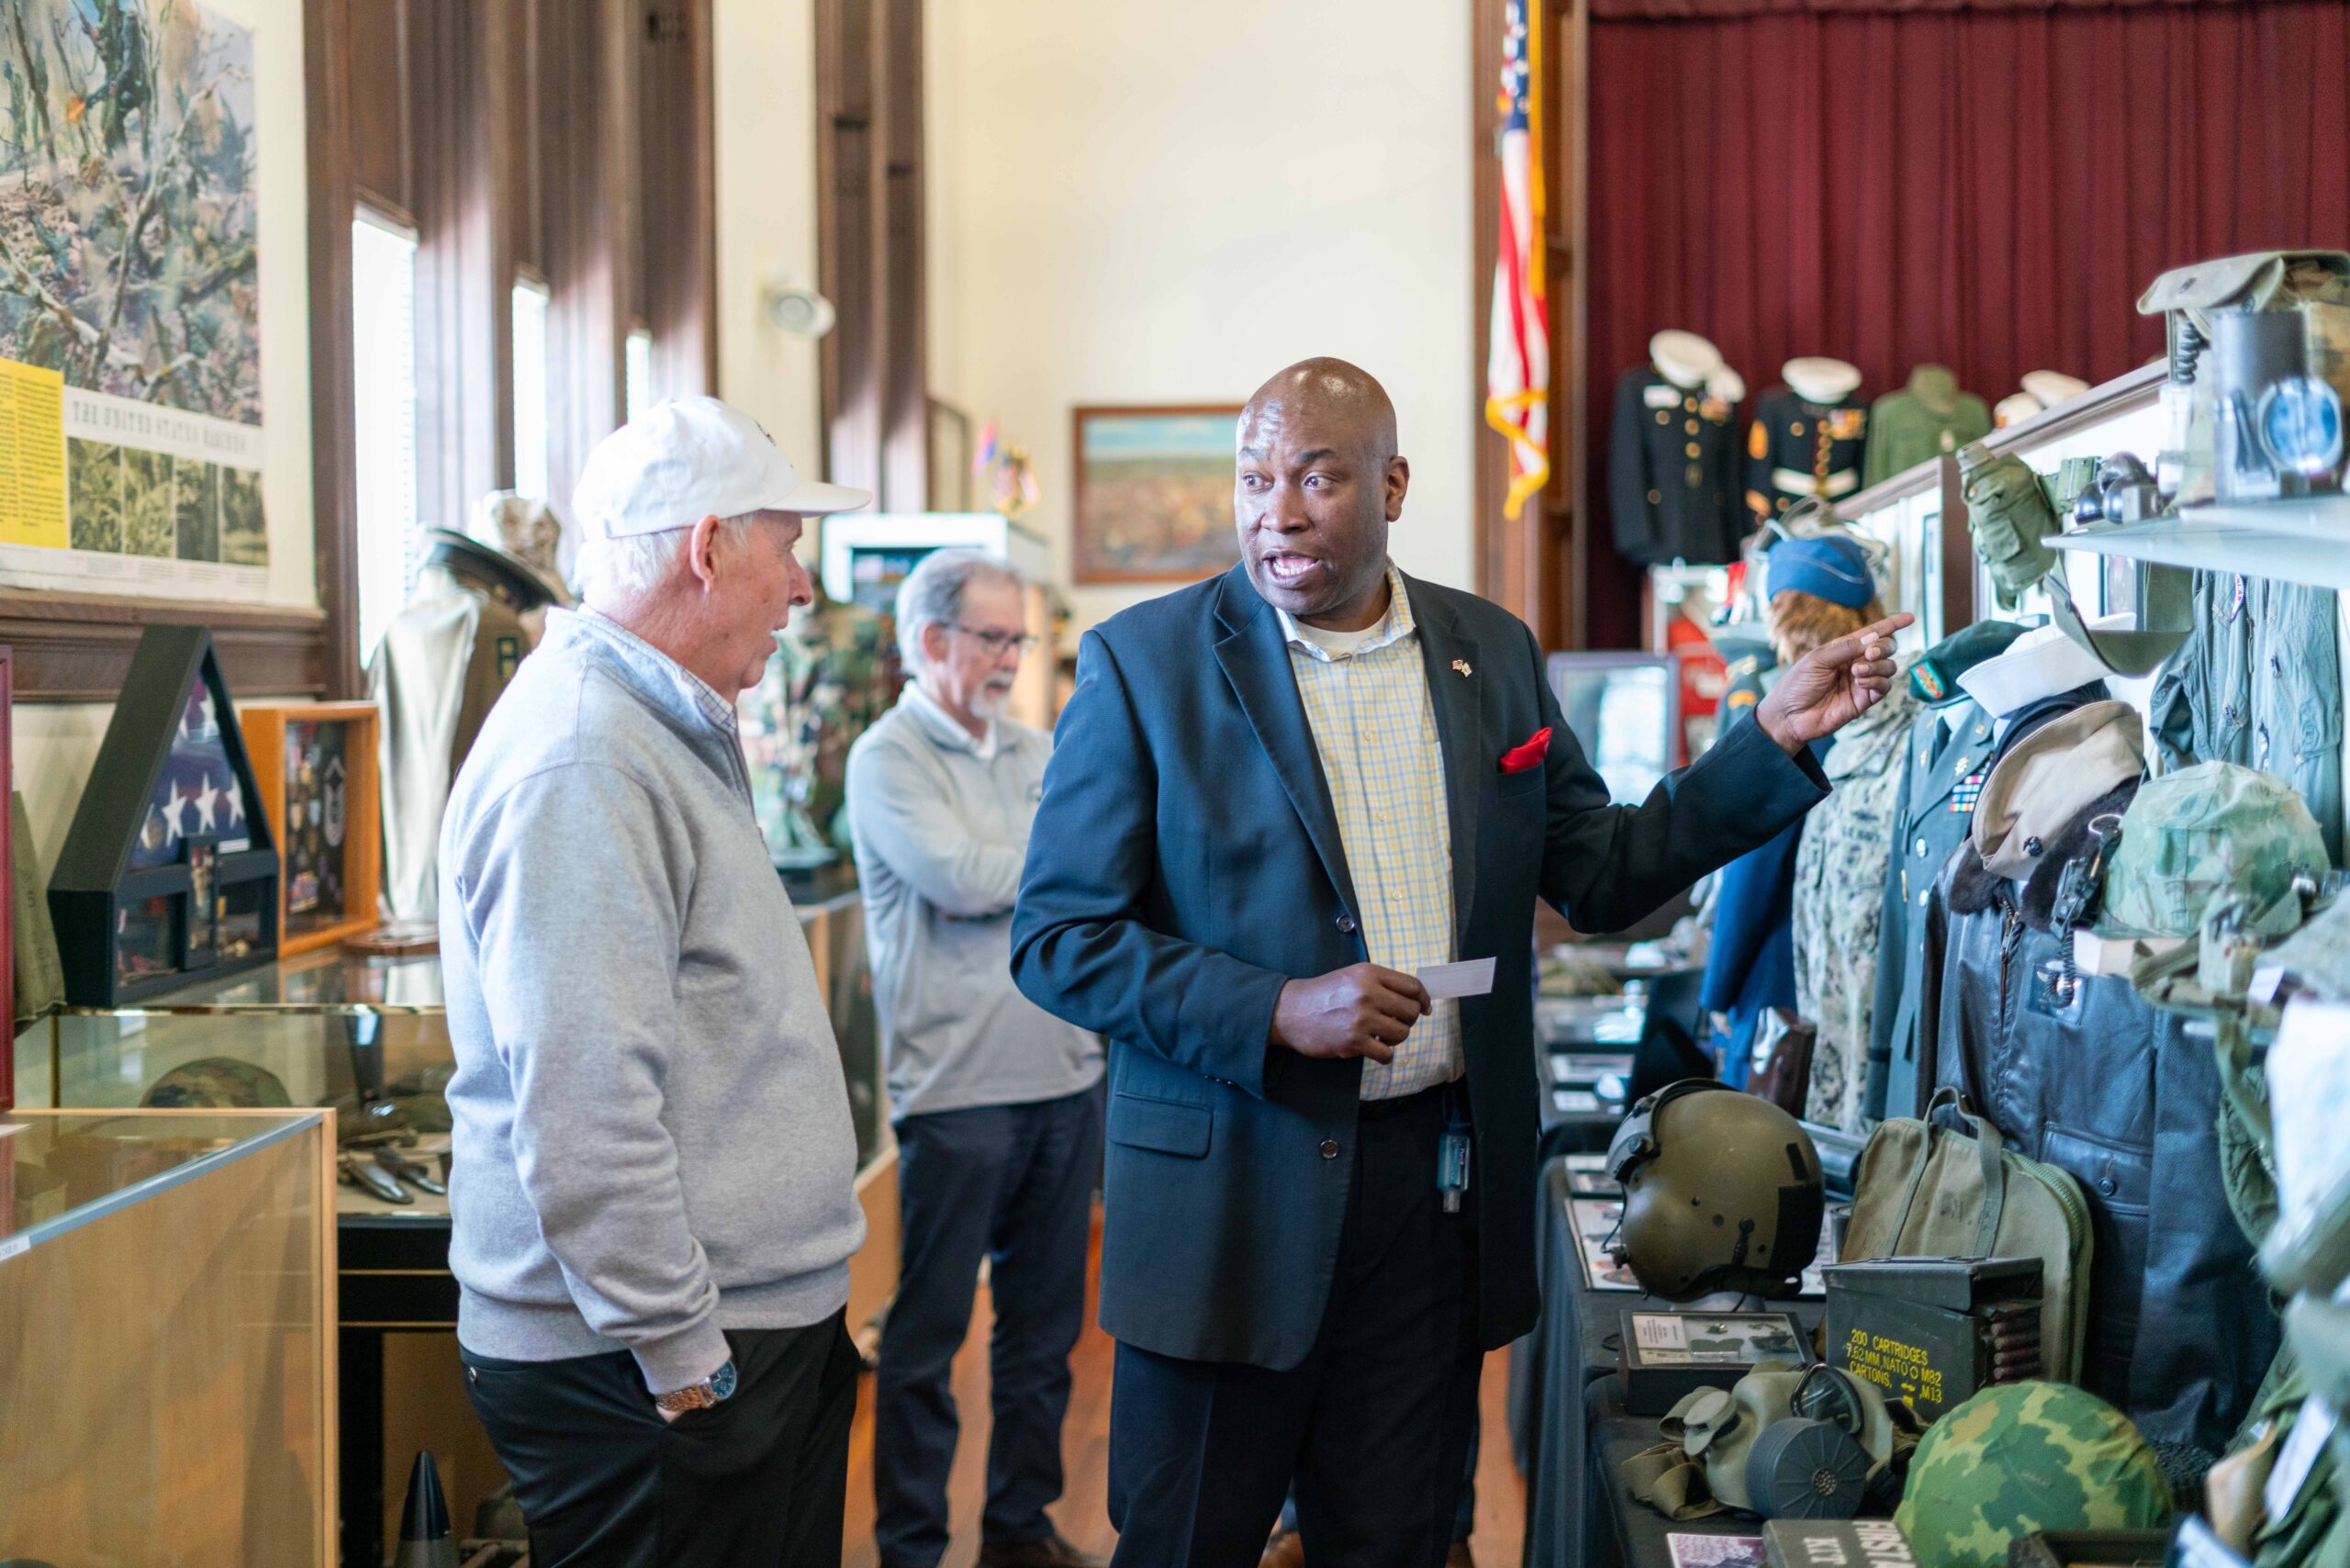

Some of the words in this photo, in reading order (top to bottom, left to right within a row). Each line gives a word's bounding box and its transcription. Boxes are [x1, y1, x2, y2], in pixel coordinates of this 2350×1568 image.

[73, 400, 98, 425] THE
[103, 406, 151, 434] UNITED
[1845, 1342, 1864, 1361] 7.62
[1883, 1355, 1908, 1376] NATO
[1851, 1328, 1868, 1347] 200
[1873, 1336, 1929, 1366] CARTRIDGES
[1802, 1537, 1848, 1565] KIT
[1852, 1520, 1912, 1561] FIRST
